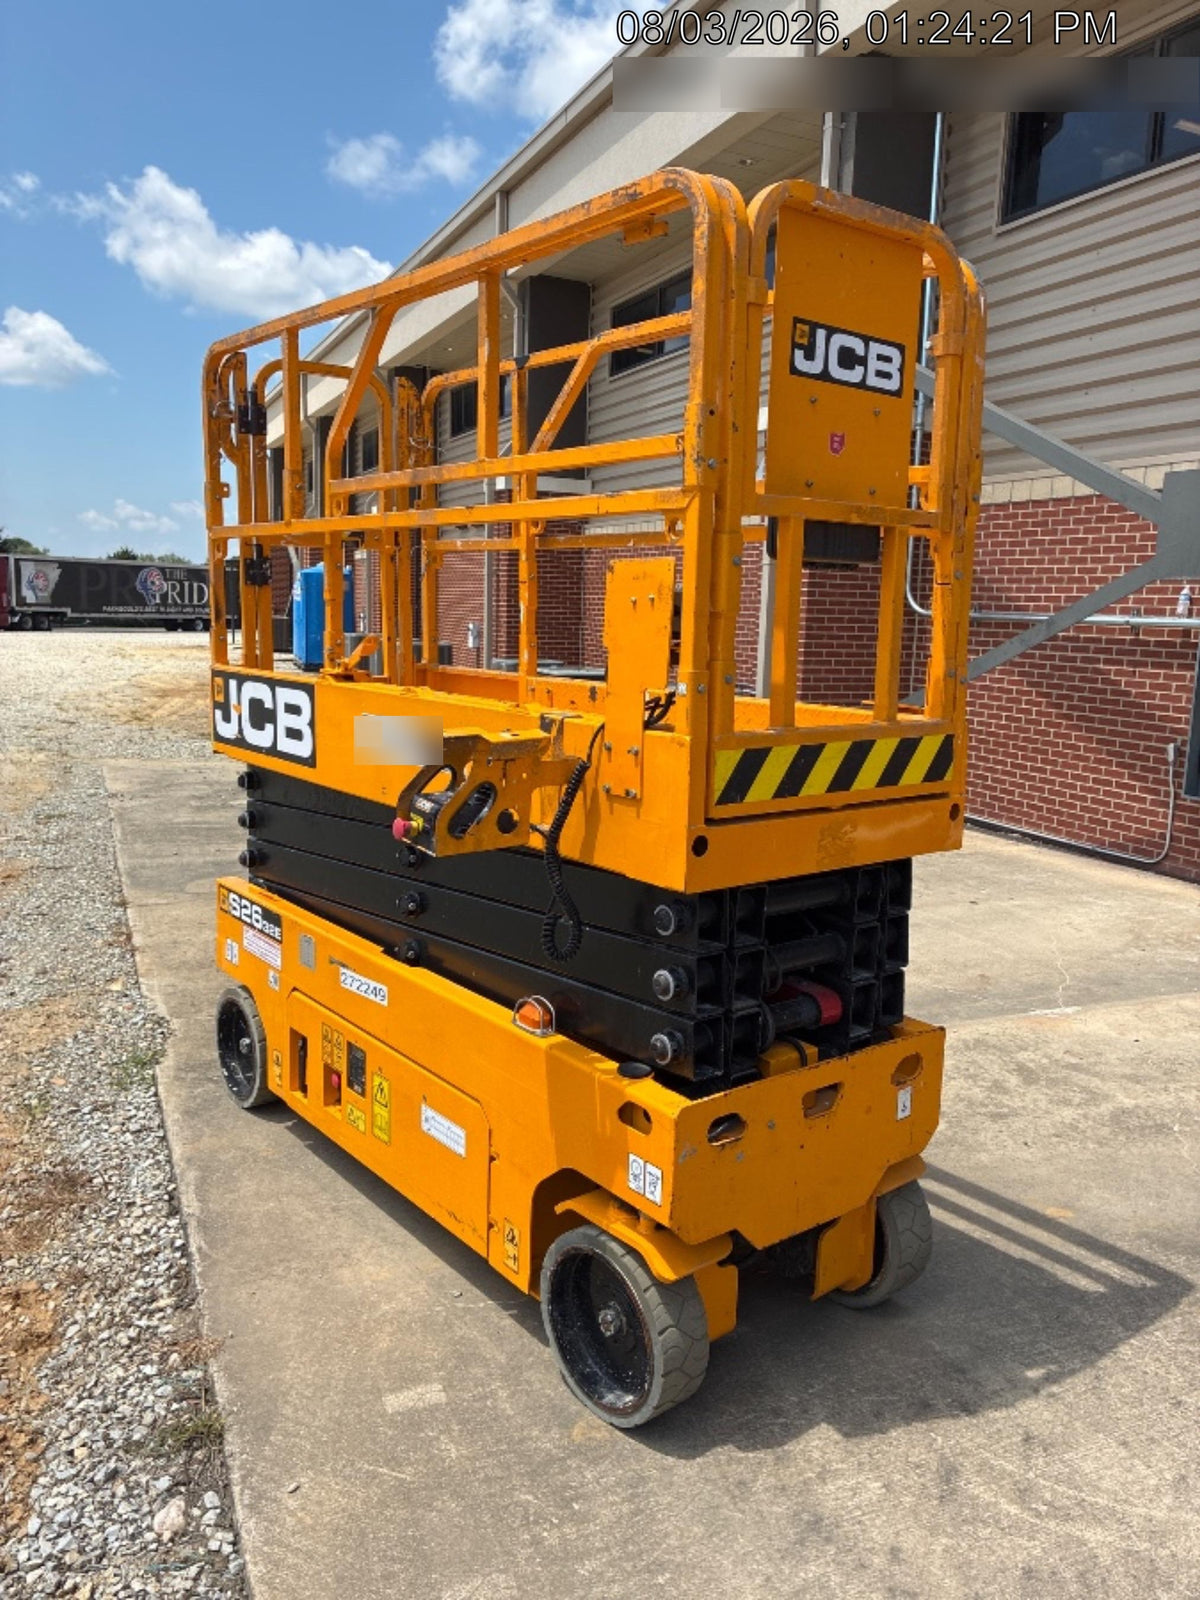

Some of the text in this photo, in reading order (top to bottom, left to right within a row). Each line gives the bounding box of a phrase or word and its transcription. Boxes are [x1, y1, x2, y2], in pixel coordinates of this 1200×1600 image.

[794, 328, 902, 391] JCB
[165, 568, 187, 580] THE
[155, 580, 208, 605] PRID
[214, 678, 313, 758] JCB
[341, 972, 386, 1002] 272249
